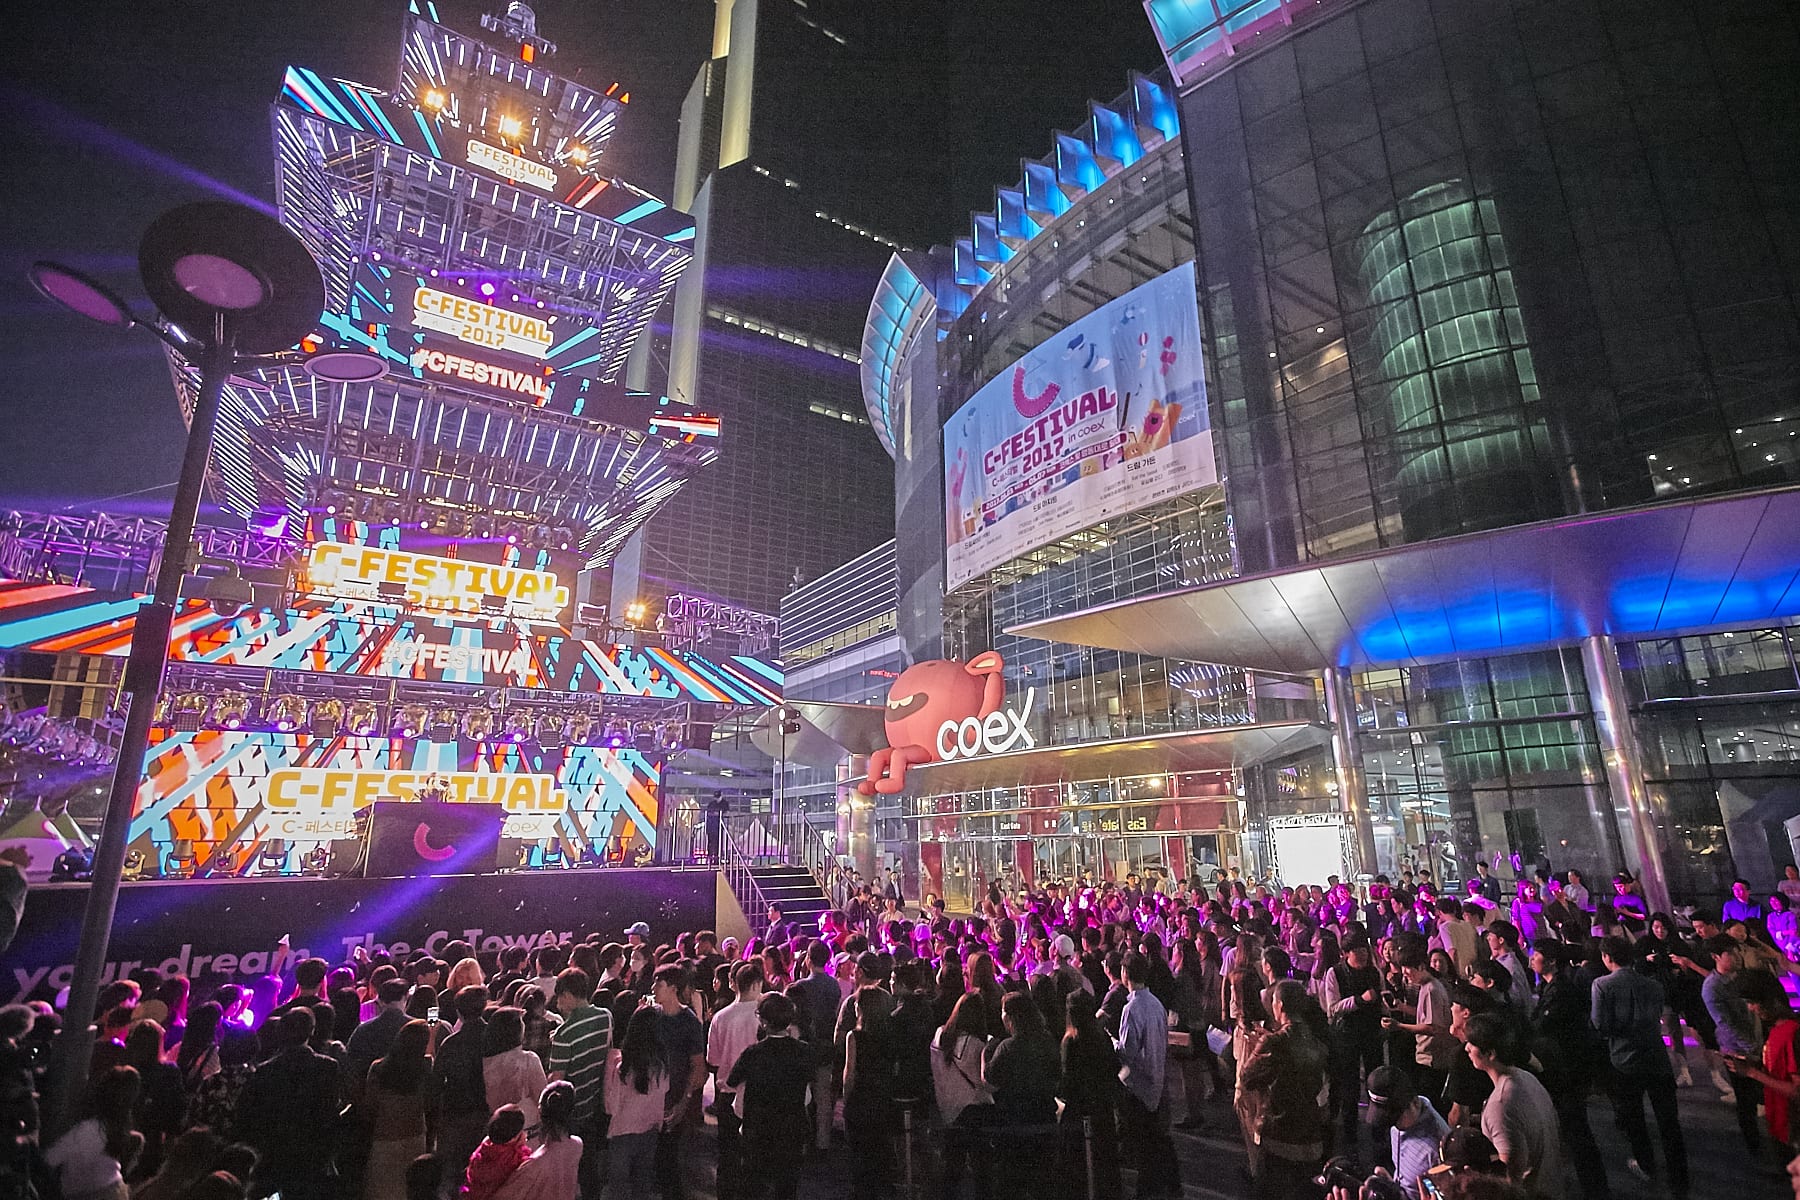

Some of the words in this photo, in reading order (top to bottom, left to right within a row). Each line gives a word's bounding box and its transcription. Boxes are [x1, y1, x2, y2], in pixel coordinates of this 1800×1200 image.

[469, 142, 555, 181] C-FESTIVAL
[498, 166, 525, 179] 2017
[416, 290, 552, 343] C-FESTIVAL
[461, 324, 505, 347] 2017
[412, 348, 550, 399] #CFESTIVAL
[984, 387, 1117, 475] C-FESTIVAL
[1022, 436, 1064, 474] 2017
[1068, 434, 1076, 443] in
[1078, 418, 1105, 438] coex
[382, 640, 538, 676] #CFESTIVAL
[936, 686, 1035, 761] coex
[158, 944, 310, 980] dream
[342, 933, 411, 960] The
[424, 930, 449, 956] C
[463, 928, 573, 952] Tower
